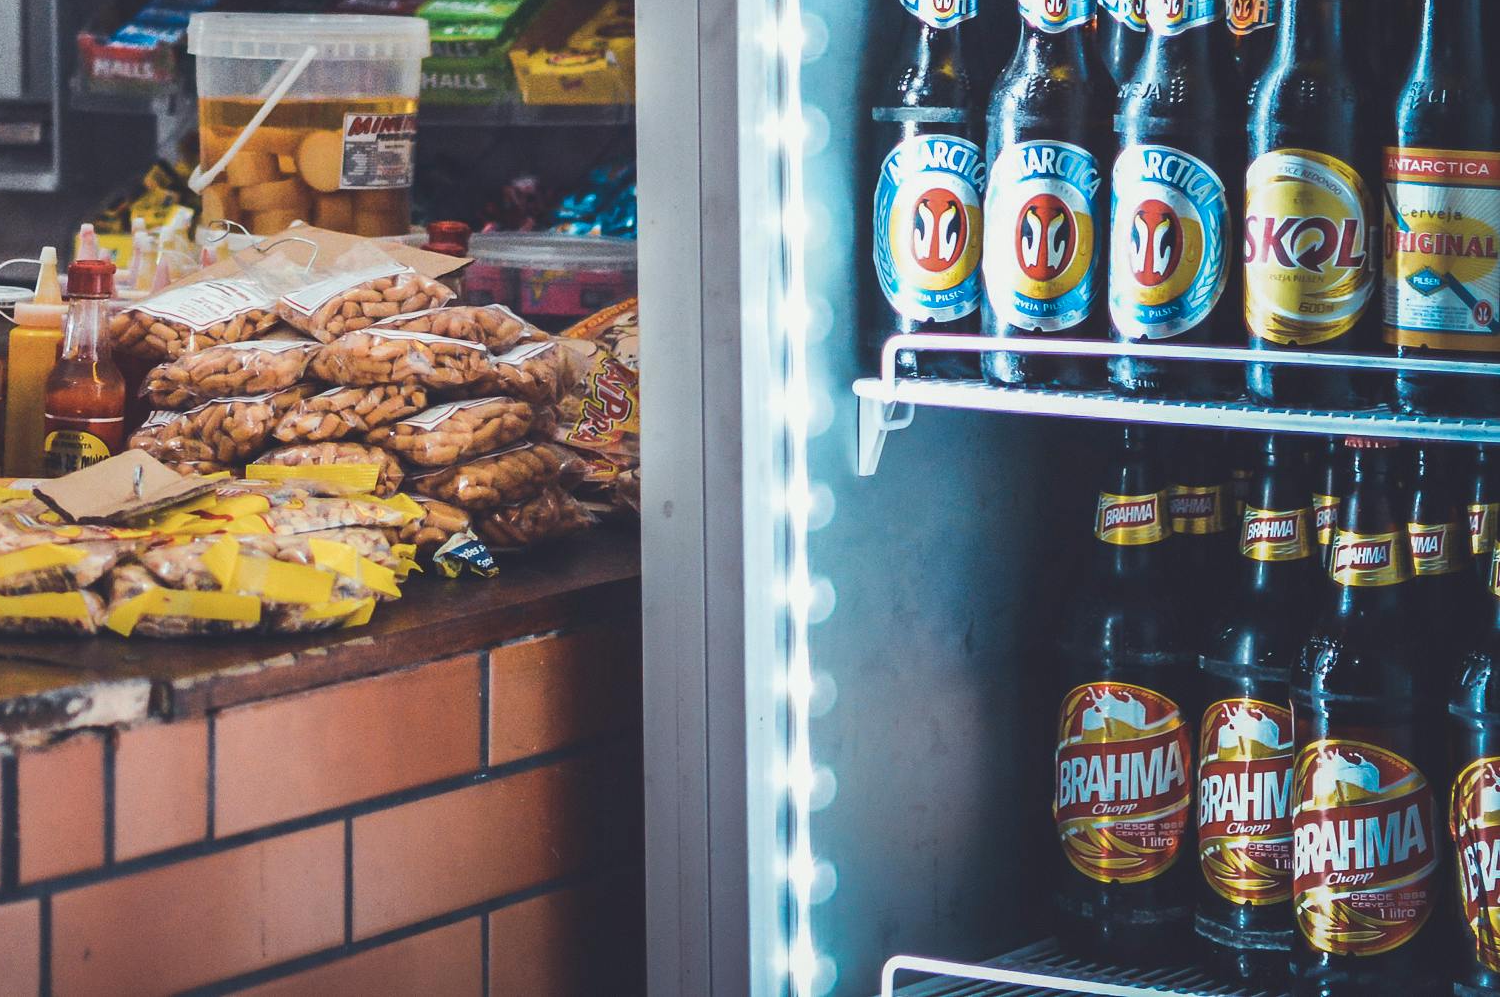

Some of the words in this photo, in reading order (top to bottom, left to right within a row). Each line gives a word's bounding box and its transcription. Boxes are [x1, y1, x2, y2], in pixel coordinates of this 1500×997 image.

[1388, 159, 1490, 175] ANTARCTICA
[1400, 204, 1462, 222] Cerveja
[1244, 216, 1367, 274] SKOL
[1384, 223, 1498, 259] ORIGINAL
[1412, 275, 1441, 286] PILSEN
[1105, 503, 1153, 528] BRAHMA
[1247, 520, 1294, 540] BRAHMA
[1059, 740, 1186, 809] BRAHMA
[1200, 769, 1293, 827] BRAHM
[1092, 803, 1138, 816] Chopp
[1226, 822, 1271, 835] Chopp
[1141, 838, 1146, 847] 1
[1150, 837, 1174, 847] litro
[1294, 804, 1427, 880] BRAHMA
[1325, 871, 1375, 885] Chopp
[1351, 893, 1394, 901] DESDE
[1380, 908, 1385, 919] 1
[1390, 908, 1416, 919] litro
